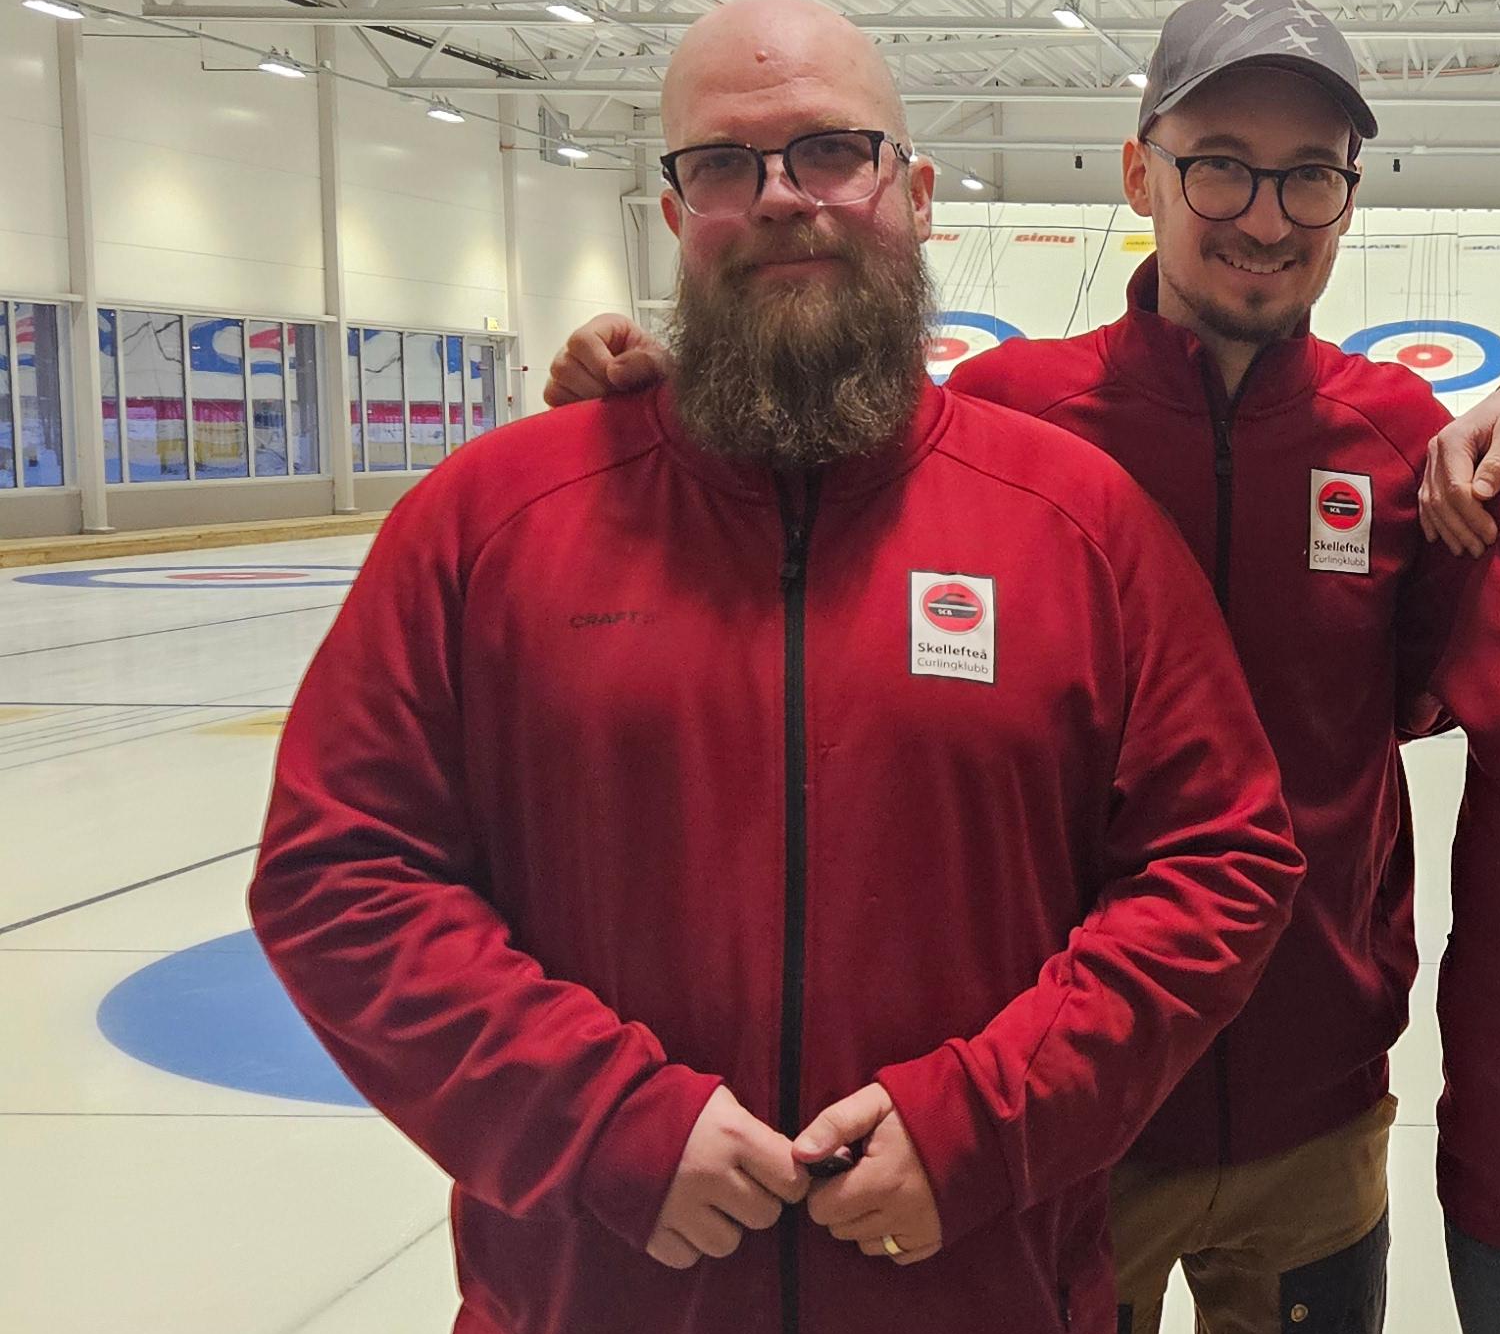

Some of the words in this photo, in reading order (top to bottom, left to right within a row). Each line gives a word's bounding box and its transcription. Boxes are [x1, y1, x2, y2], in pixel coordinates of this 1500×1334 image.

[1313, 540, 1366, 555] Skellefteå
[1312, 554, 1366, 567] Curlingklubb
[917, 642, 988, 660] Skellefteå
[917, 657, 989, 674] Curlingklubb
